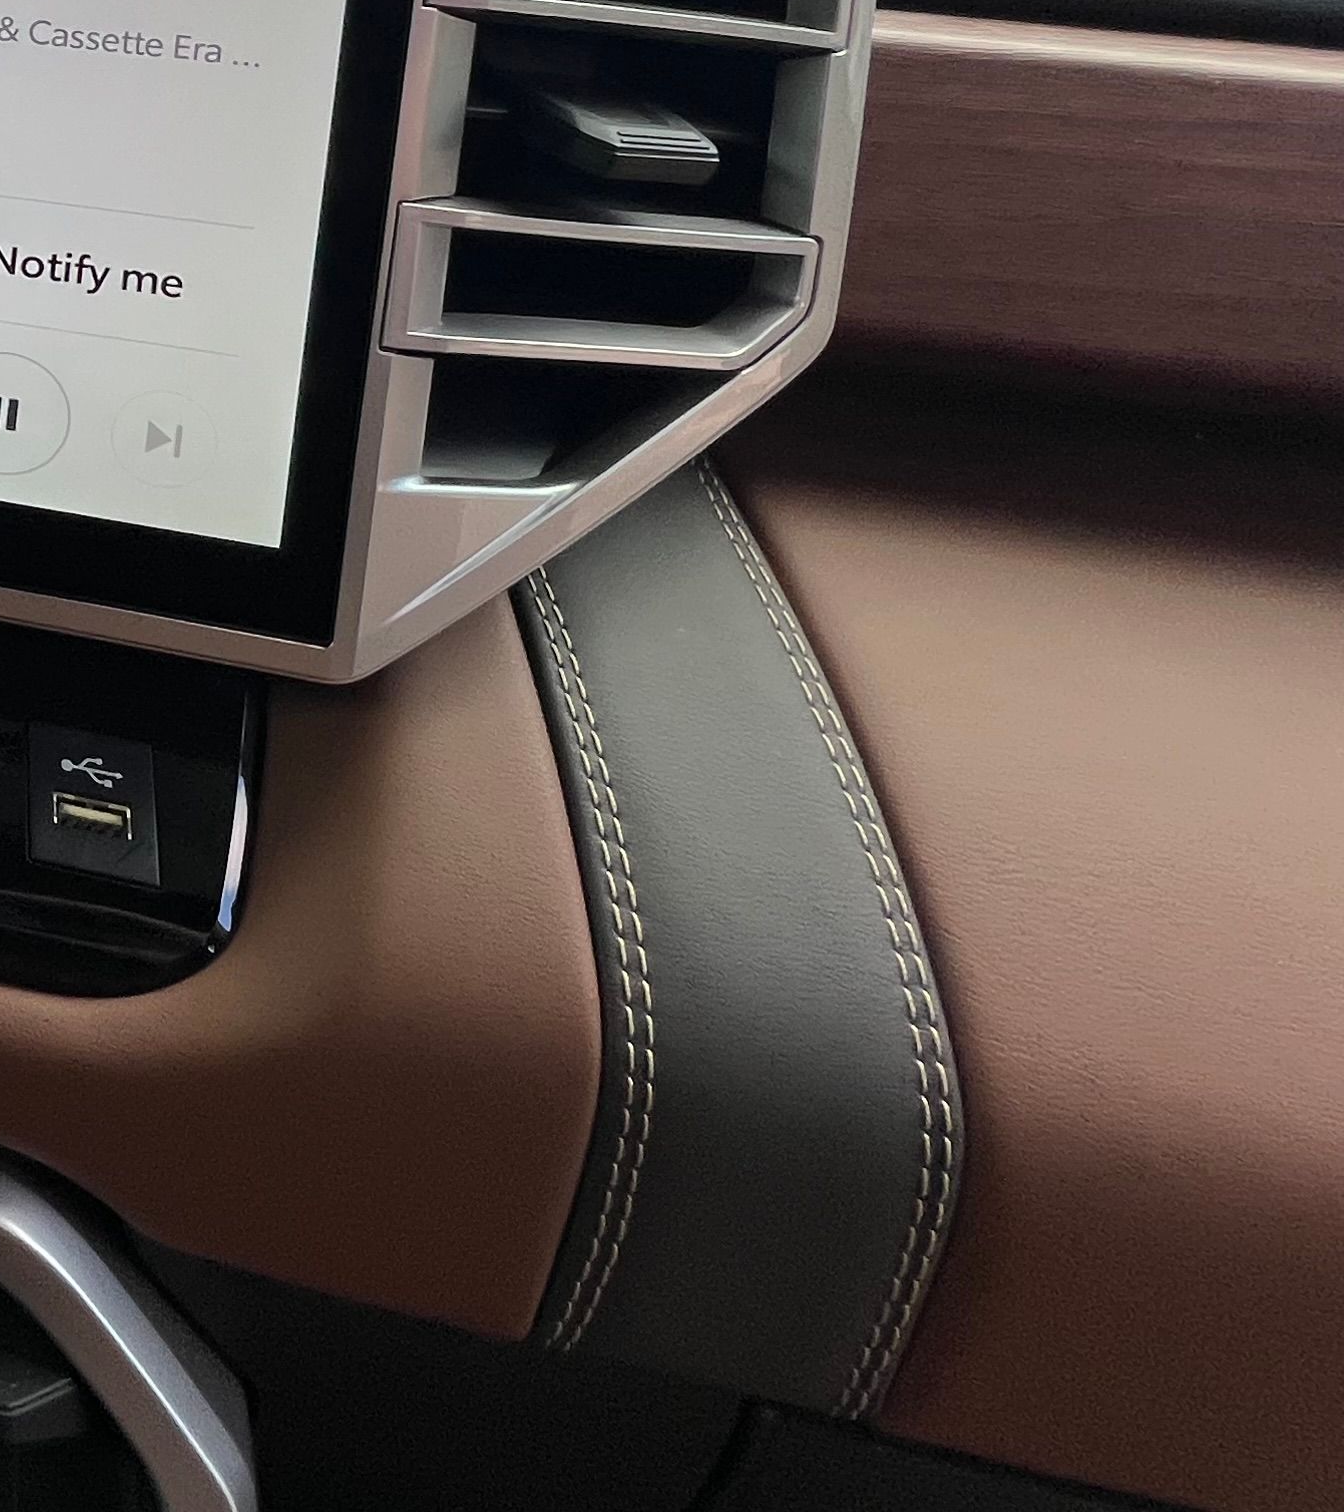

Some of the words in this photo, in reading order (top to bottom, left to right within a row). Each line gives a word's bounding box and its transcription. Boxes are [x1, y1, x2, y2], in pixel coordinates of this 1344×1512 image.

[28, 19, 164, 60] Cassette
[173, 36, 223, 65] Era
[122, 265, 184, 300] me
